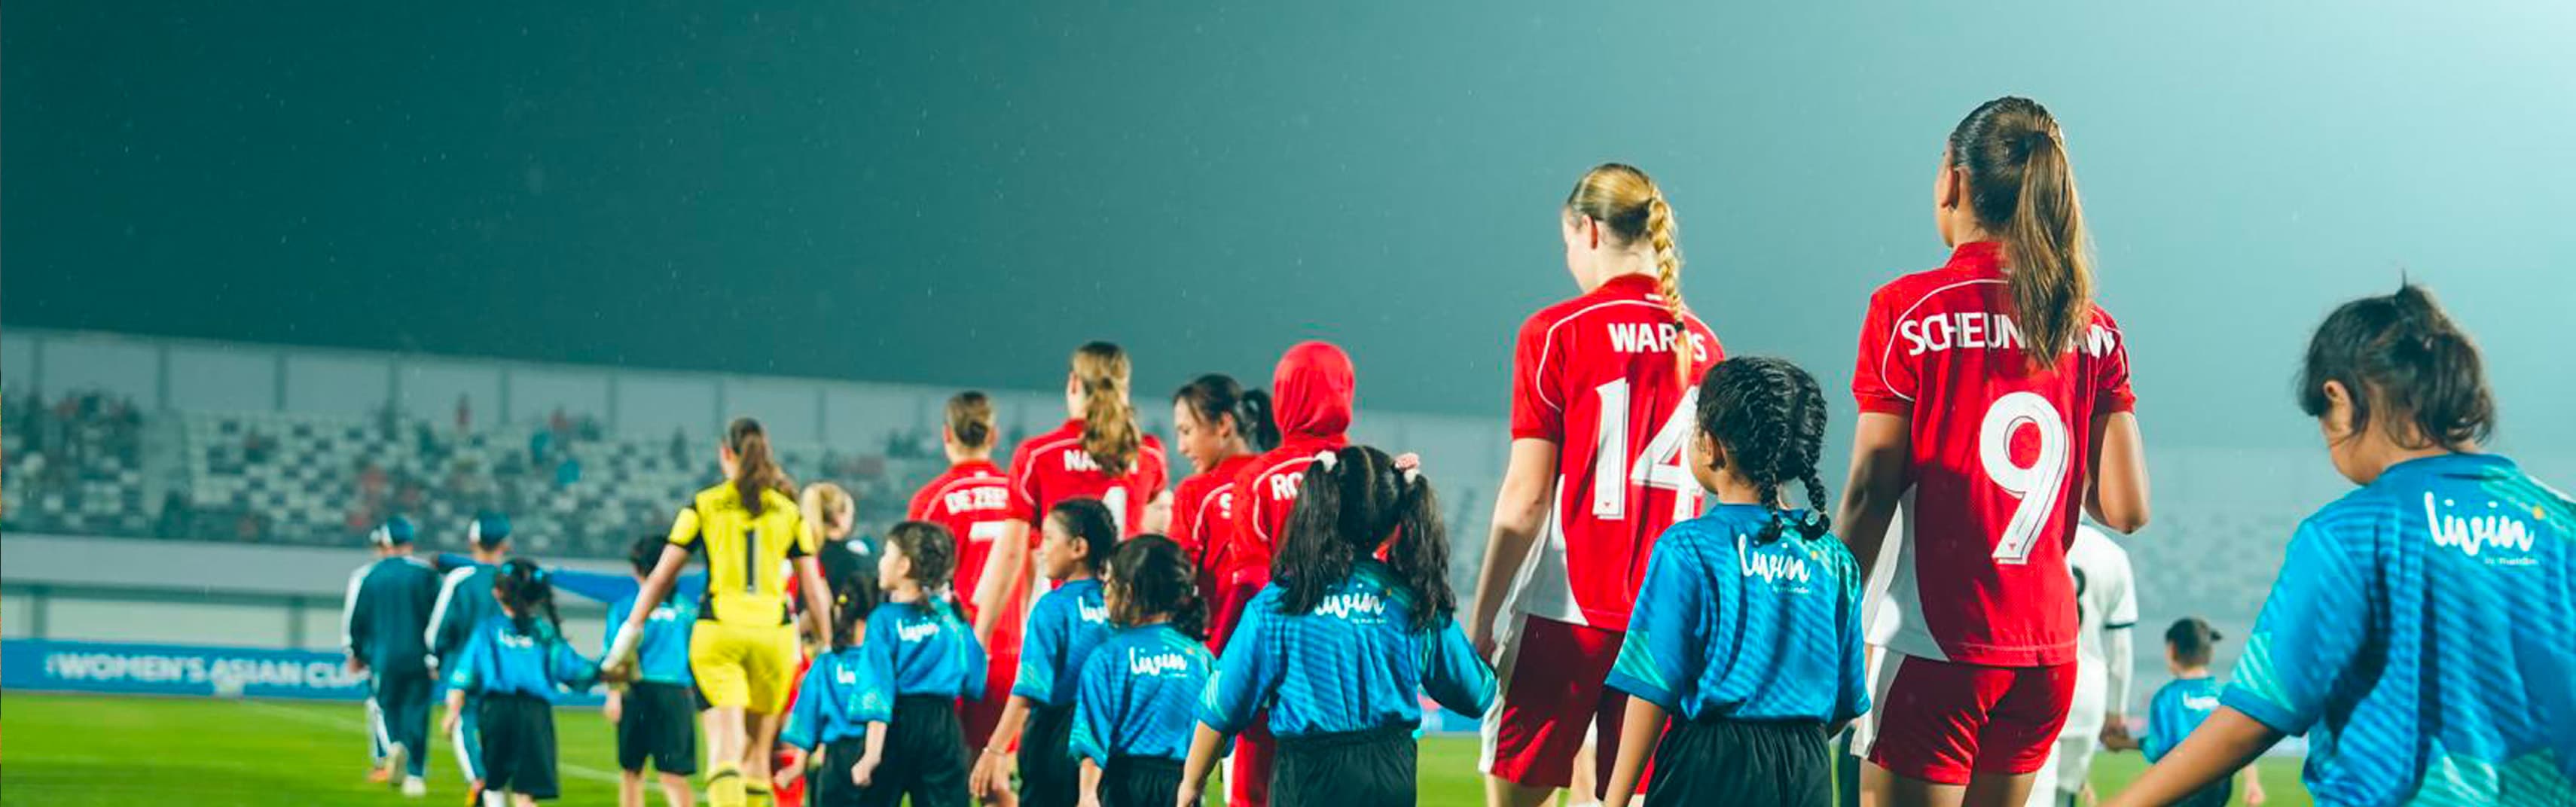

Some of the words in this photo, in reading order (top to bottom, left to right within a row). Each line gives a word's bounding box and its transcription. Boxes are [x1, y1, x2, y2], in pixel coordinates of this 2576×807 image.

[1593, 376, 1705, 526] 14
[1979, 391, 2070, 565] 9
[743, 528, 758, 592] 1
